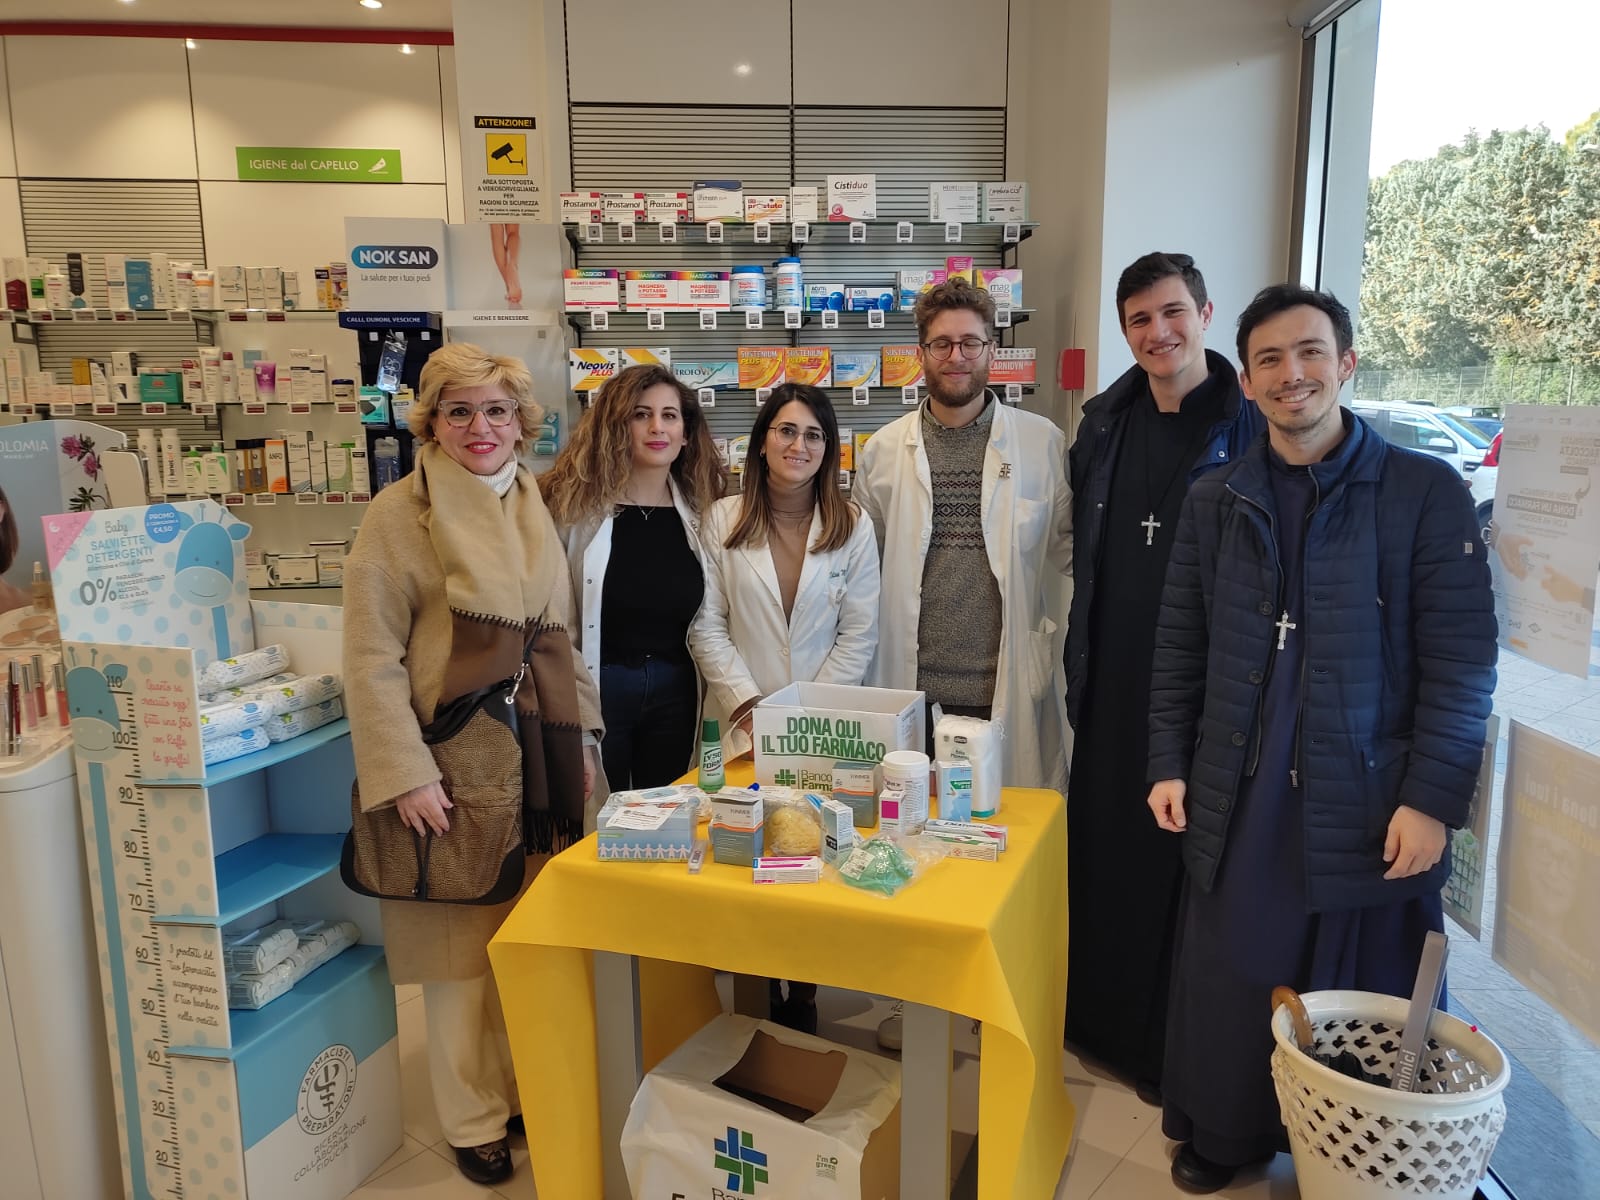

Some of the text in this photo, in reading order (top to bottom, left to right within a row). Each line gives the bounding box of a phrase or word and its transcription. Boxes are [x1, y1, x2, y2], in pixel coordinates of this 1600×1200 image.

[478, 118, 533, 127] ATTENZIONE!
[249, 159, 288, 170] IGIENE
[310, 159, 359, 171] CAPELLO
[834, 181, 868, 190] Cistiduo
[563, 200, 597, 208] Prostamol
[606, 200, 641, 208] Prostamol
[649, 200, 683, 208] Prostamol
[359, 251, 431, 265] NOK SAN
[361, 274, 368, 282] La
[368, 274, 388, 282] salute
[416, 274, 431, 283] piedi
[990, 284, 1010, 292] mag
[576, 361, 616, 370] Neovis
[149, 512, 174, 520] PROMO
[105, 520, 128, 536] Baby
[90, 535, 145, 551] SALVIETTE
[86, 546, 153, 564] DETERGENTI
[80, 577, 117, 606] 0%
[106, 676, 123, 688] 110
[786, 716, 862, 740] DONA QUI
[112, 731, 130, 744] 100
[762, 734, 887, 762] IL TUO FARMACO
[801, 770, 833, 780] Banco
[802, 780, 833, 790] Farma
[118, 786, 133, 800] 90
[124, 840, 138, 854] 80
[128, 893, 143, 906] 70
[136, 946, 148, 960] 60
[141, 998, 155, 1012] 50
[147, 1050, 160, 1062] 40
[301, 1047, 351, 1093] FARMACISTI
[1396, 1049, 1416, 1092] minici
[152, 1100, 165, 1113] 30
[302, 1080, 354, 1132] PREPARATORI
[314, 1123, 348, 1155] RICERCA
[294, 1115, 367, 1182] COLLABORAZIONE
[155, 1150, 168, 1163] 20
[316, 1142, 349, 1174] FIDUCIA
[816, 1154, 829, 1162] I'm
[816, 1161, 836, 1170] green
